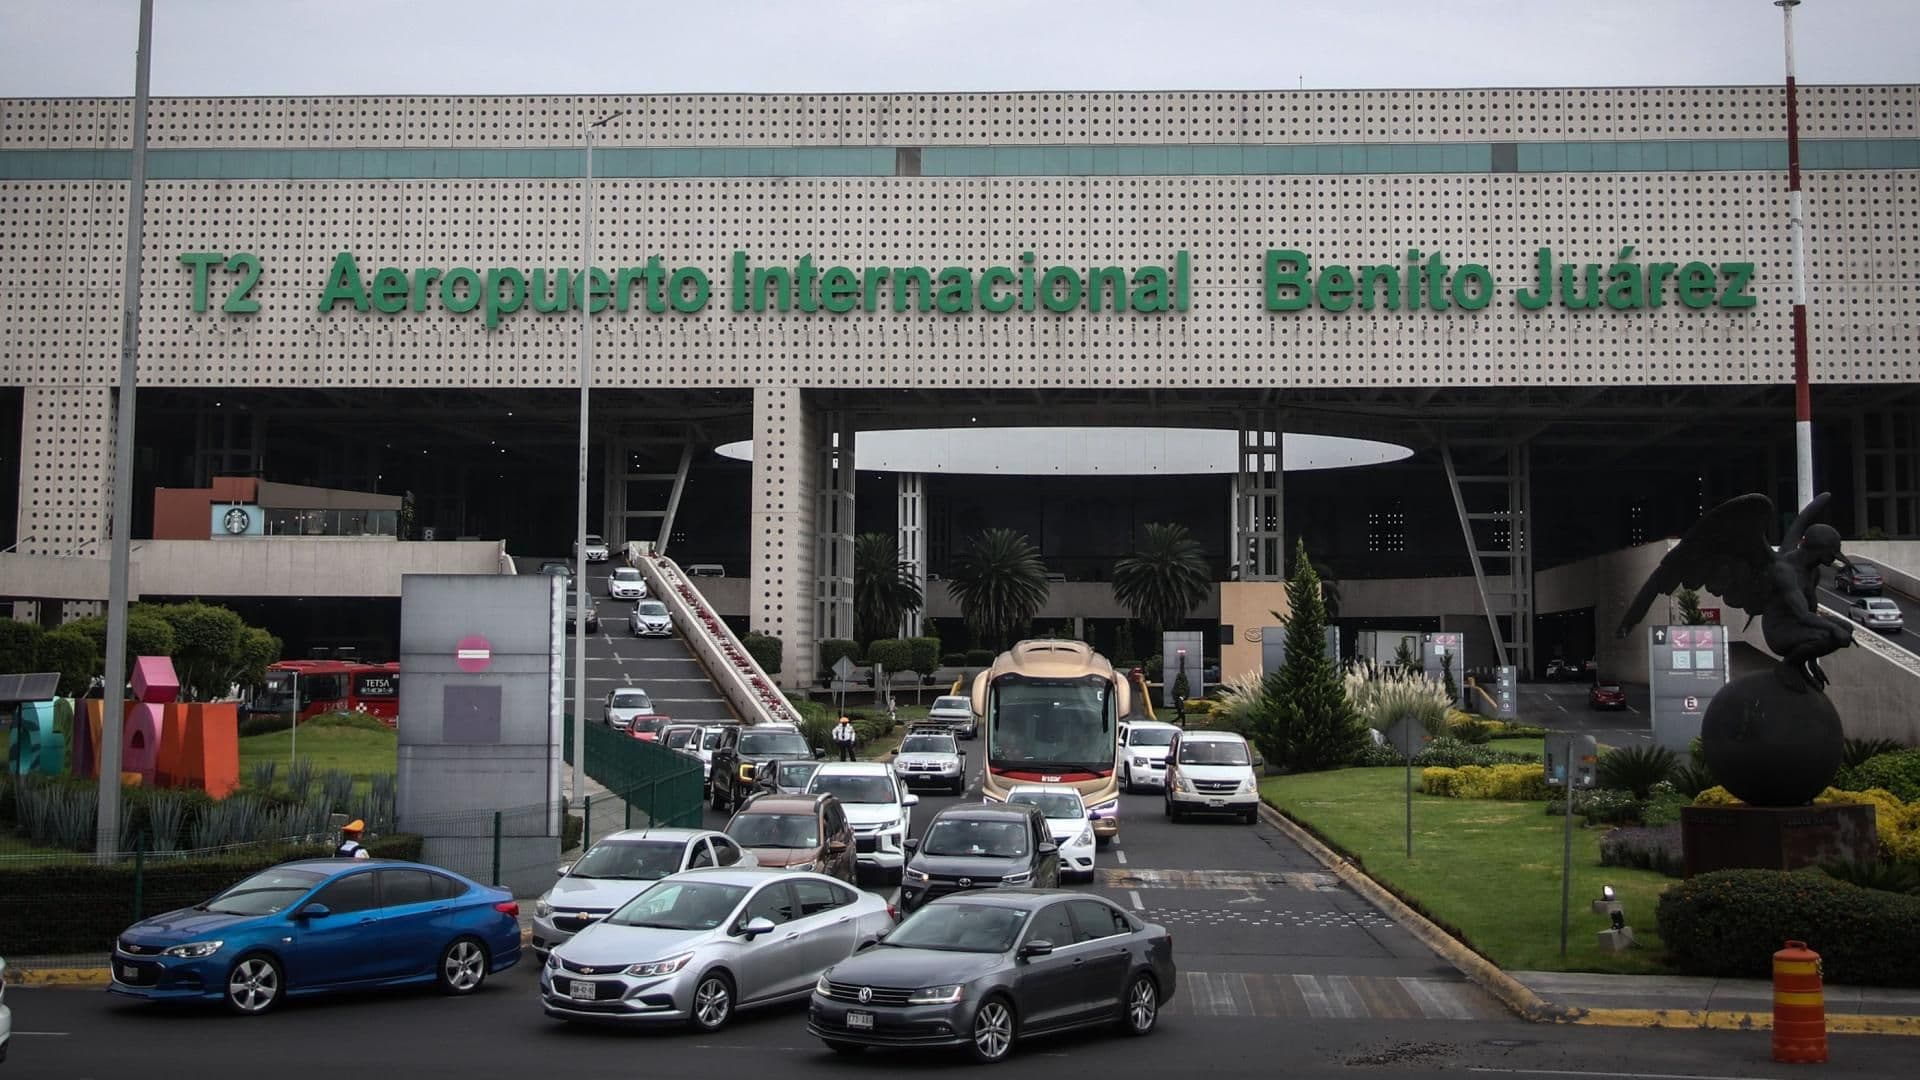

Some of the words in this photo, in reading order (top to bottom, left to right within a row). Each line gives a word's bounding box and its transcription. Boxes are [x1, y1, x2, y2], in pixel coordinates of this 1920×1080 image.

[181, 252, 262, 313] T2
[318, 252, 711, 329] Aeropuerto
[732, 250, 1189, 313] Internacional
[1266, 248, 1494, 312] Benito
[1516, 246, 1757, 310] Juárez
[365, 679, 390, 687] TETSA
